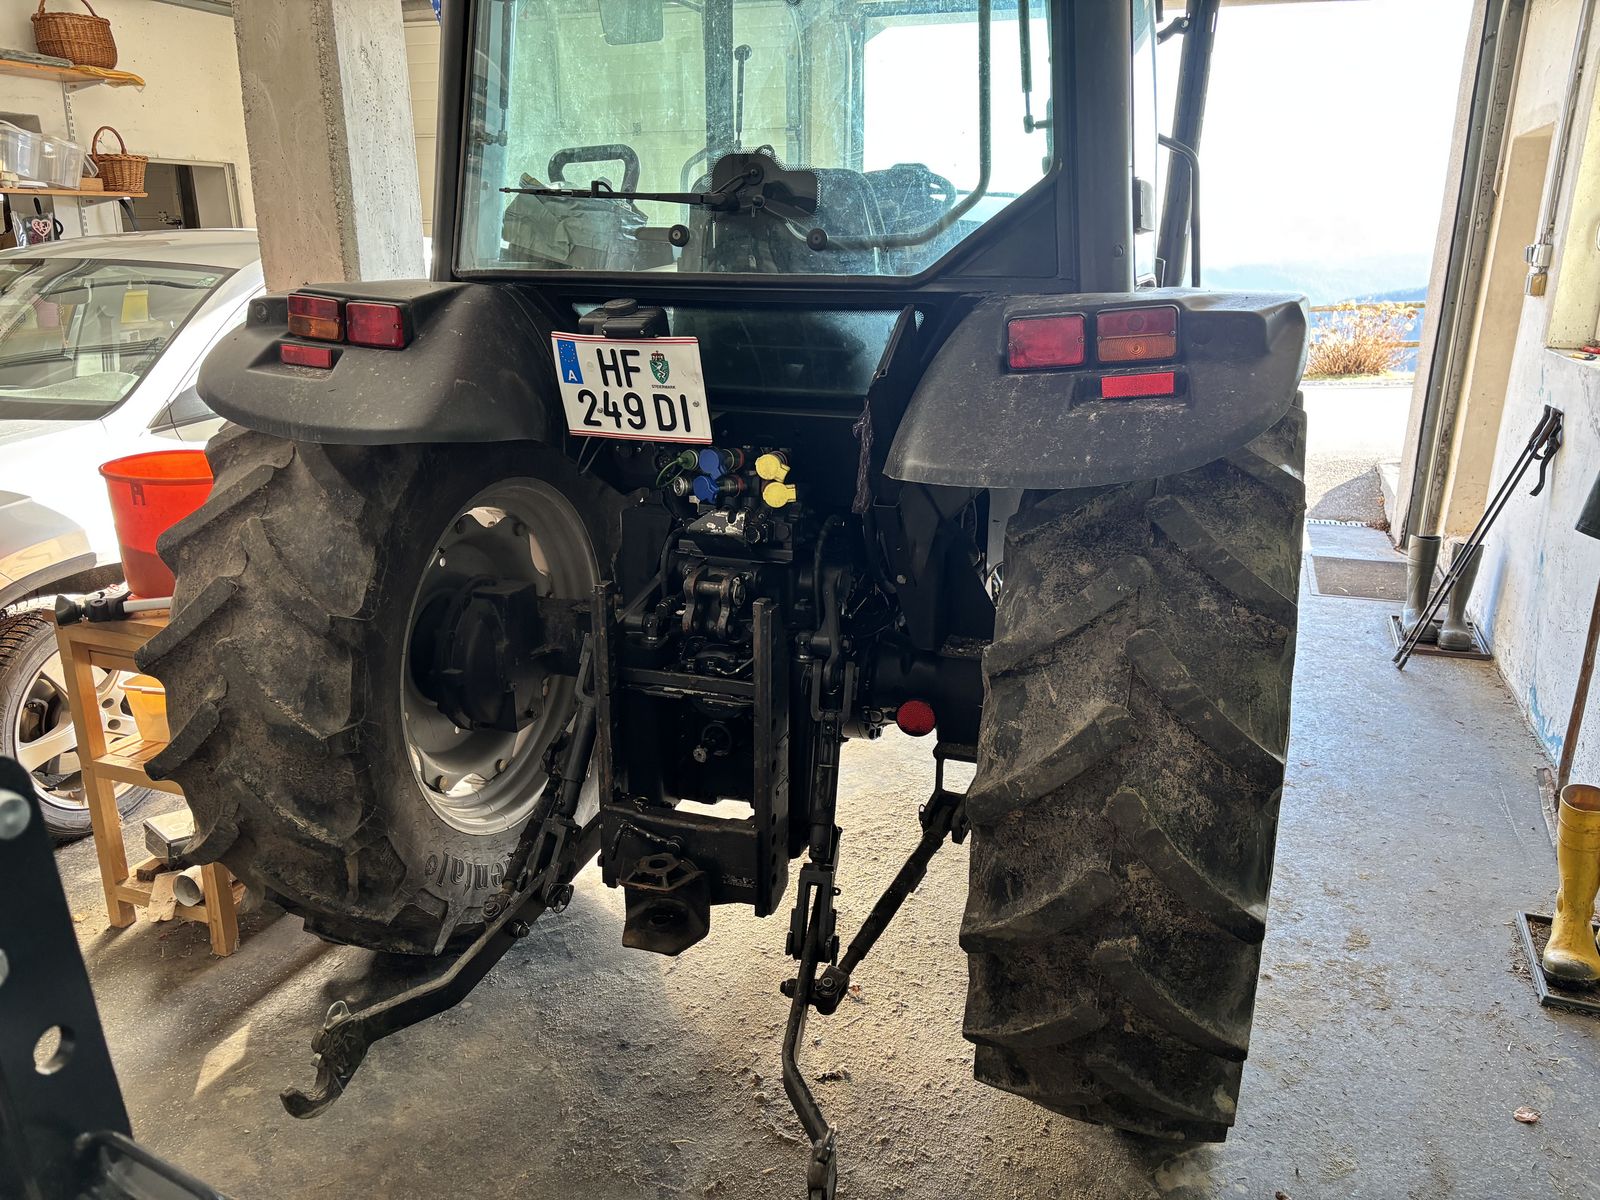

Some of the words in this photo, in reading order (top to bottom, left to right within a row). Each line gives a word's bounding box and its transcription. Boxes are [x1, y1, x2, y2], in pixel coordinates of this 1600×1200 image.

[568, 370, 578, 382] A
[596, 347, 641, 388] HF
[577, 389, 647, 430] 249
[652, 393, 691, 433] DI
